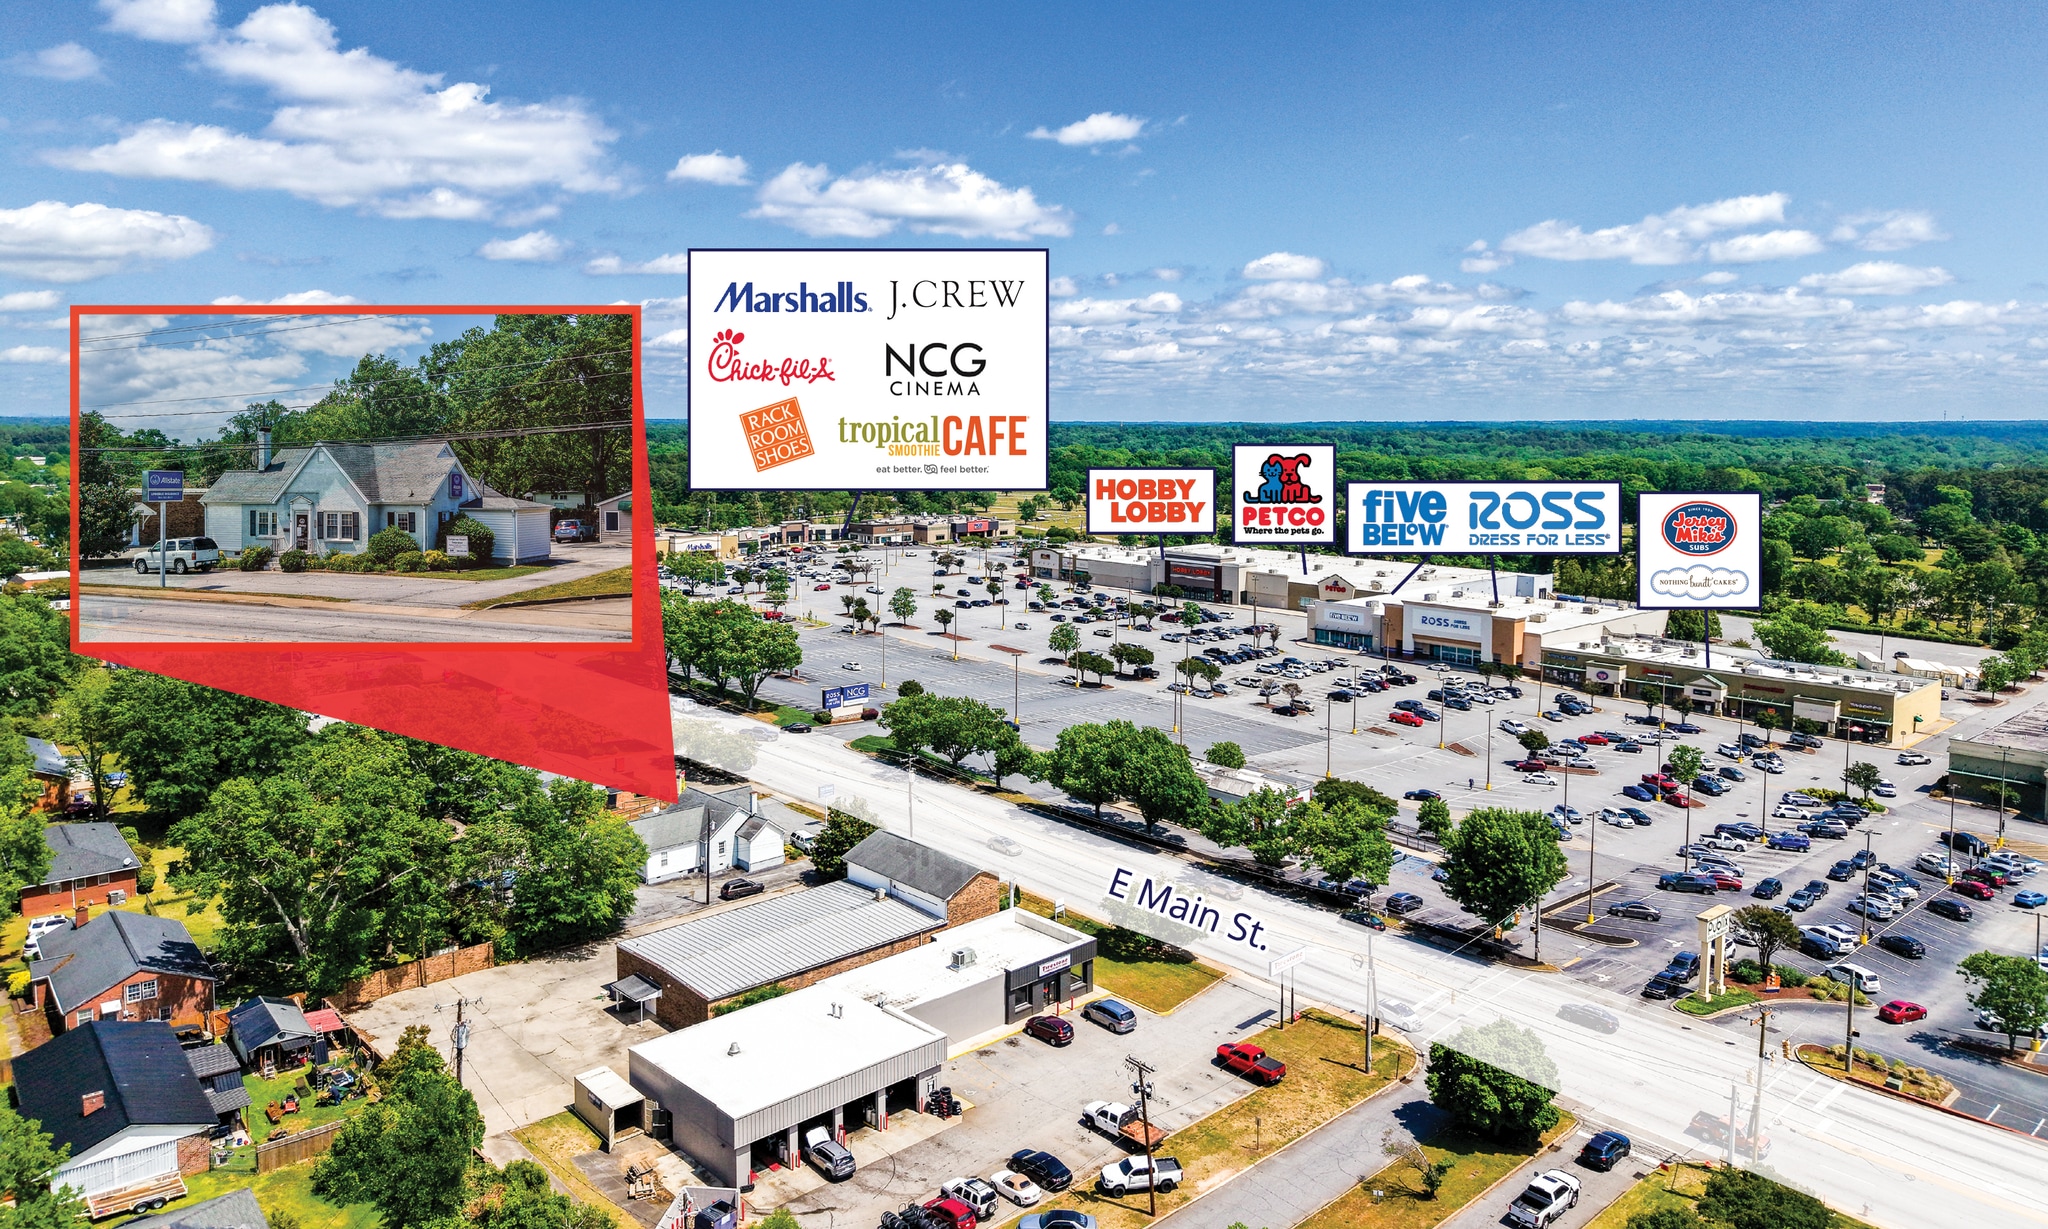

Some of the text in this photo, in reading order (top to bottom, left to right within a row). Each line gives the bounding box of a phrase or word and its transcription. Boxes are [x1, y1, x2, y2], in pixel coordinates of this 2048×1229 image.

[1325, 585, 1347, 593] PETCO
[1421, 615, 1450, 627] ROSS
[847, 686, 866, 697] NCG
